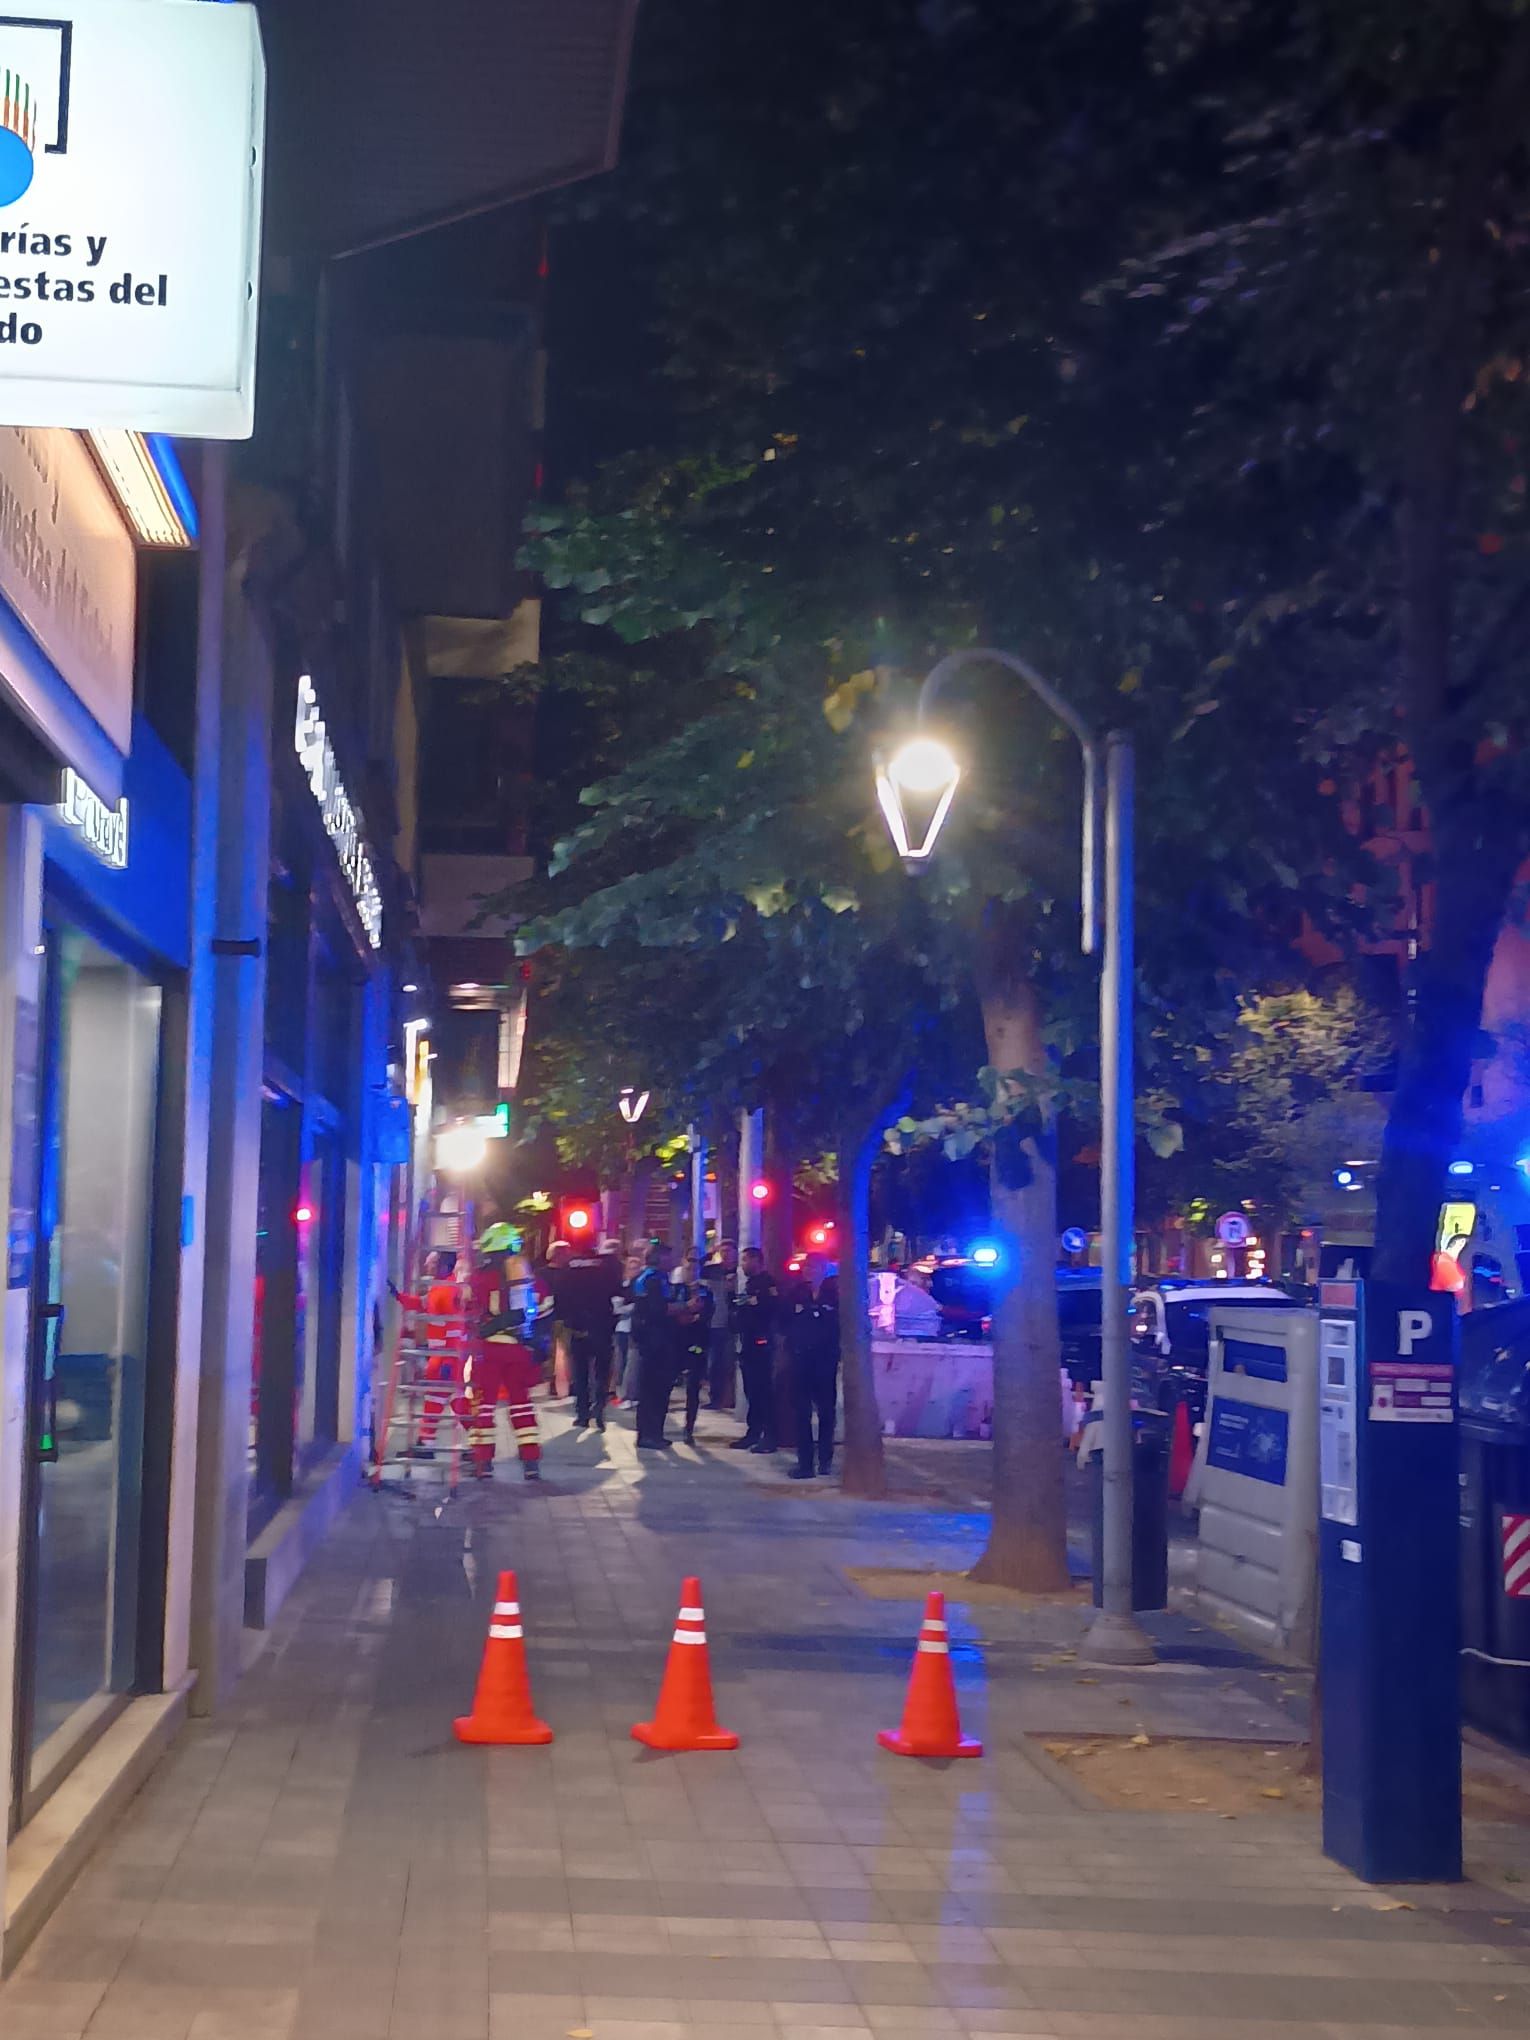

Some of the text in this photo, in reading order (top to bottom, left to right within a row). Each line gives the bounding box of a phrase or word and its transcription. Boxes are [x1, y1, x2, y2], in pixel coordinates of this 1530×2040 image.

[86, 235, 107, 267] y
[109, 272, 168, 307] del
[1398, 1310, 1433, 1355] P
